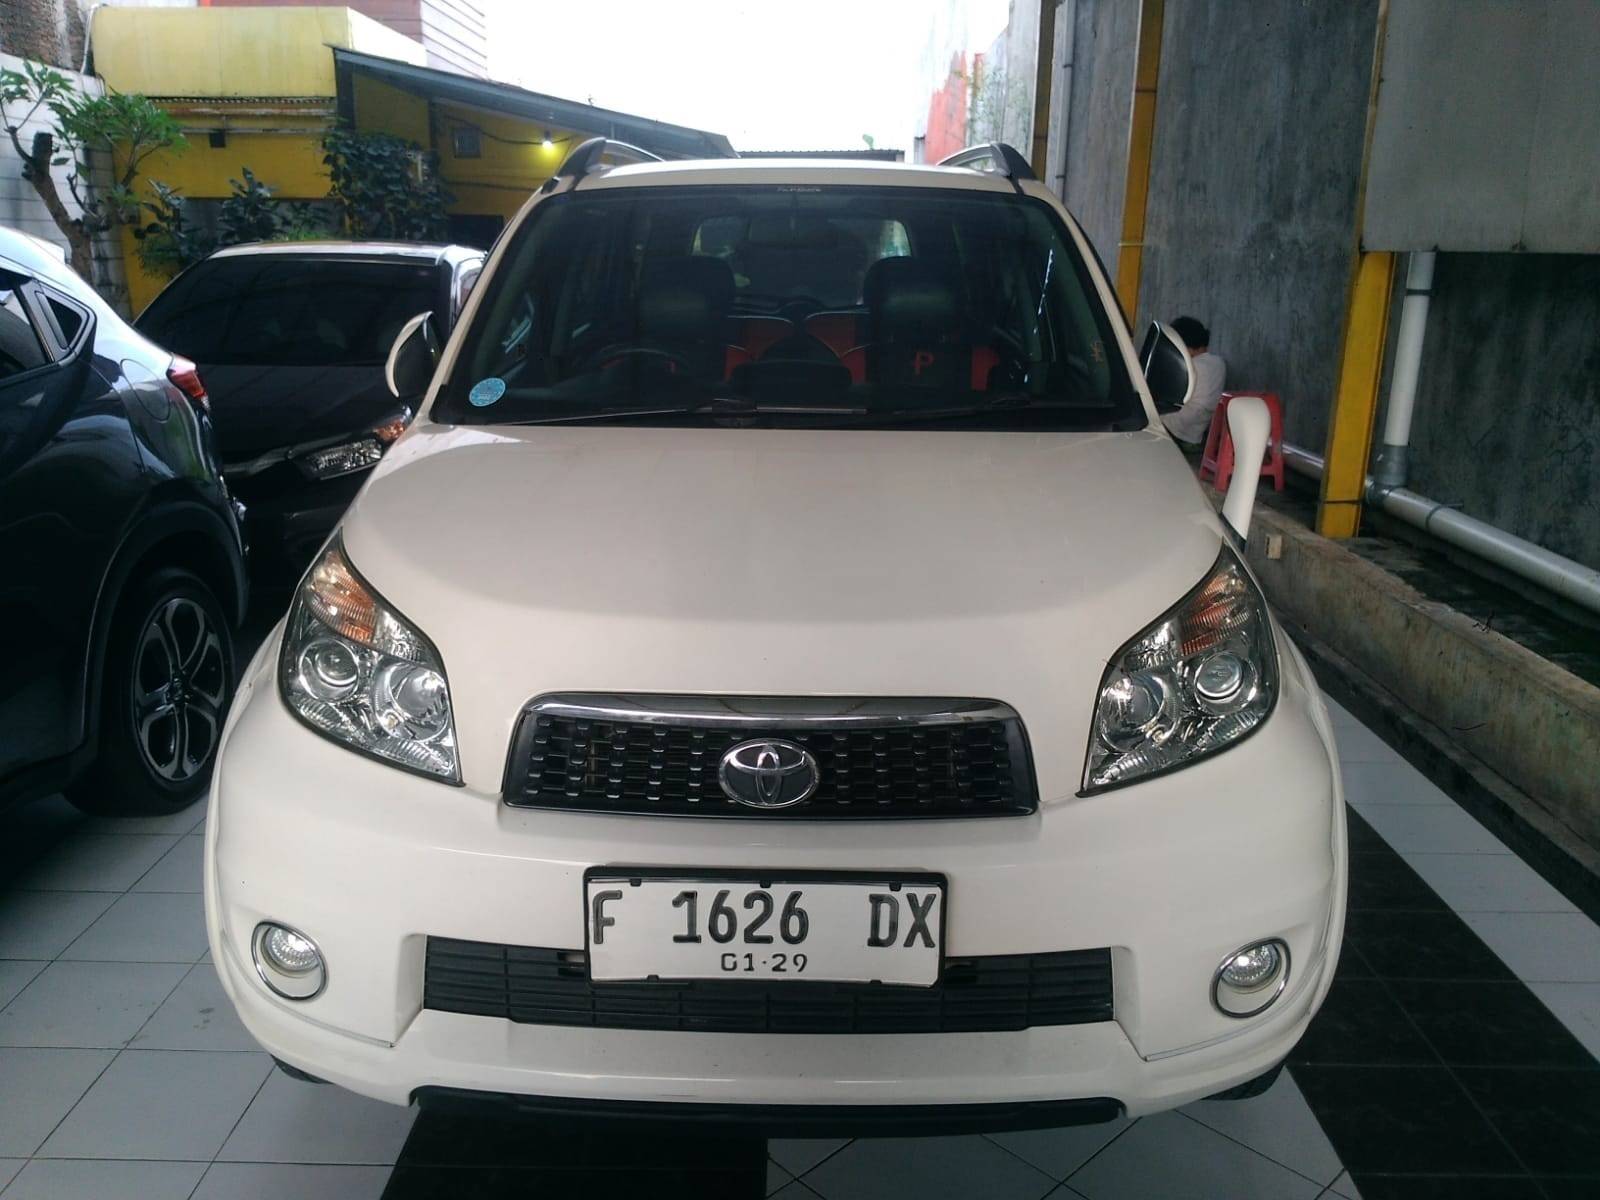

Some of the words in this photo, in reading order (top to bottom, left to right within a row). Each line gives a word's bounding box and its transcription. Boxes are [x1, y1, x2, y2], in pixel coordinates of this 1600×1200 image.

[592, 890, 623, 945] F
[671, 890, 810, 946] 1626
[867, 893, 937, 948] DX
